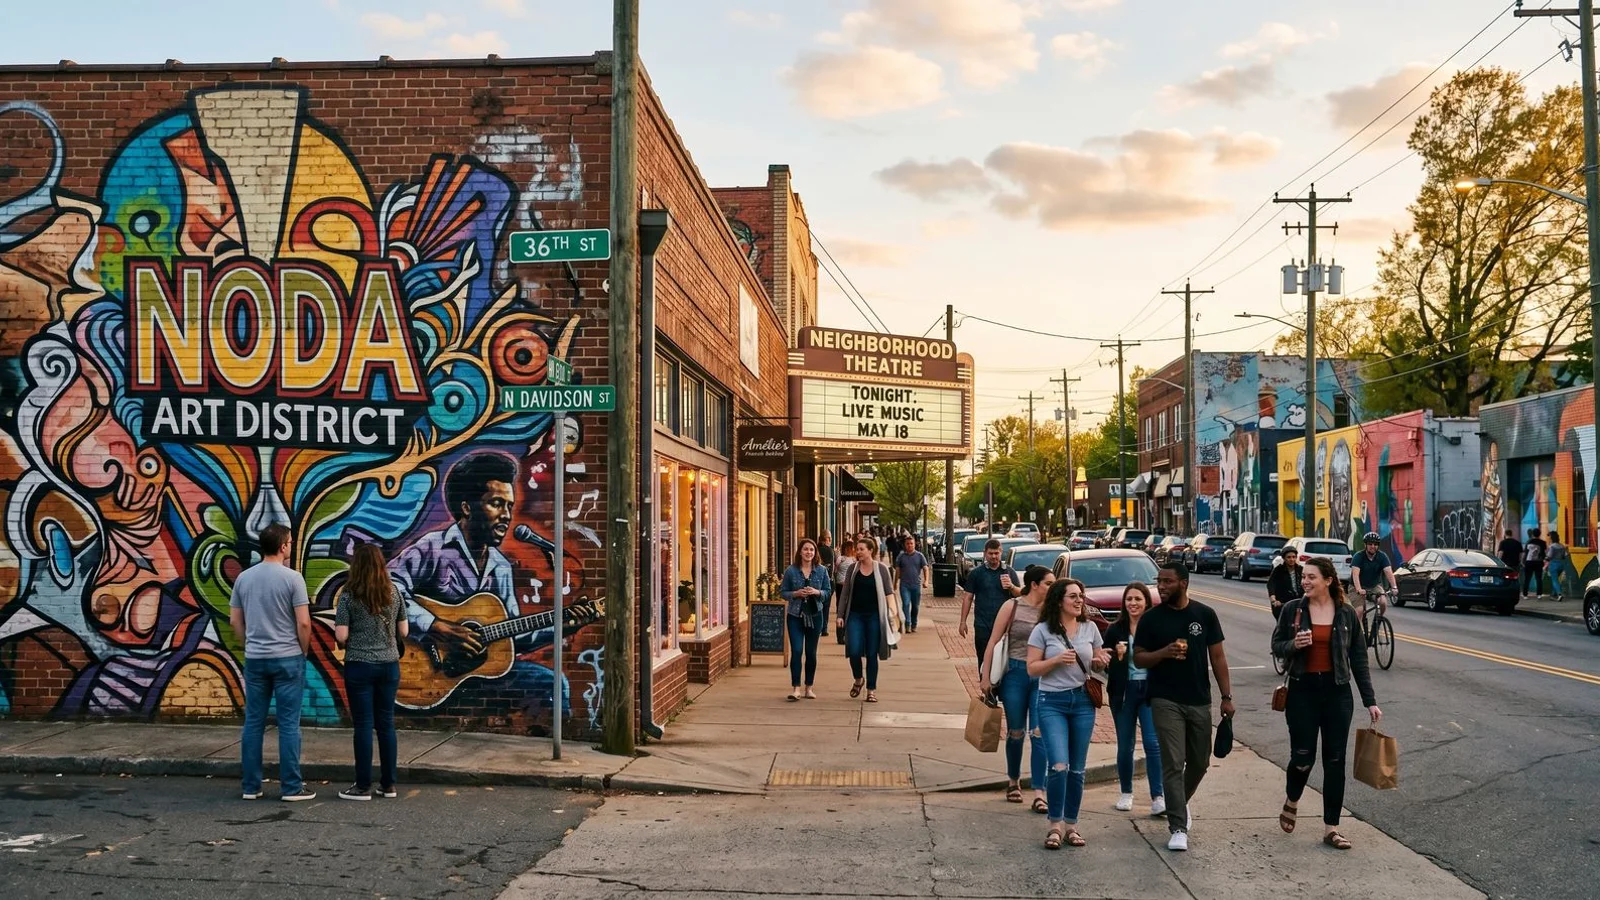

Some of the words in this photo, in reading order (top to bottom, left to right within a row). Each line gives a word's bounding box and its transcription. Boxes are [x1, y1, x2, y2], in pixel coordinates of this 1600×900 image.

[524, 236, 569, 257] 36TH
[580, 237, 597, 251] ST
[131, 262, 427, 400] NODA
[810, 329, 953, 359] NEIGHBORHOOD
[843, 354, 923, 377] THEATRE
[504, 390, 514, 408] N
[520, 389, 593, 408] DAVIDSON
[598, 392, 611, 404] ST
[851, 385, 917, 404] TONIGHT:
[151, 397, 225, 436] ART
[236, 400, 405, 446] DISTRICT
[842, 402, 874, 419] LIVE
[880, 405, 924, 422] MUSIC
[857, 422, 889, 438] MAY
[895, 424, 909, 439] 18
[741, 438, 789, 451] Amélie's
